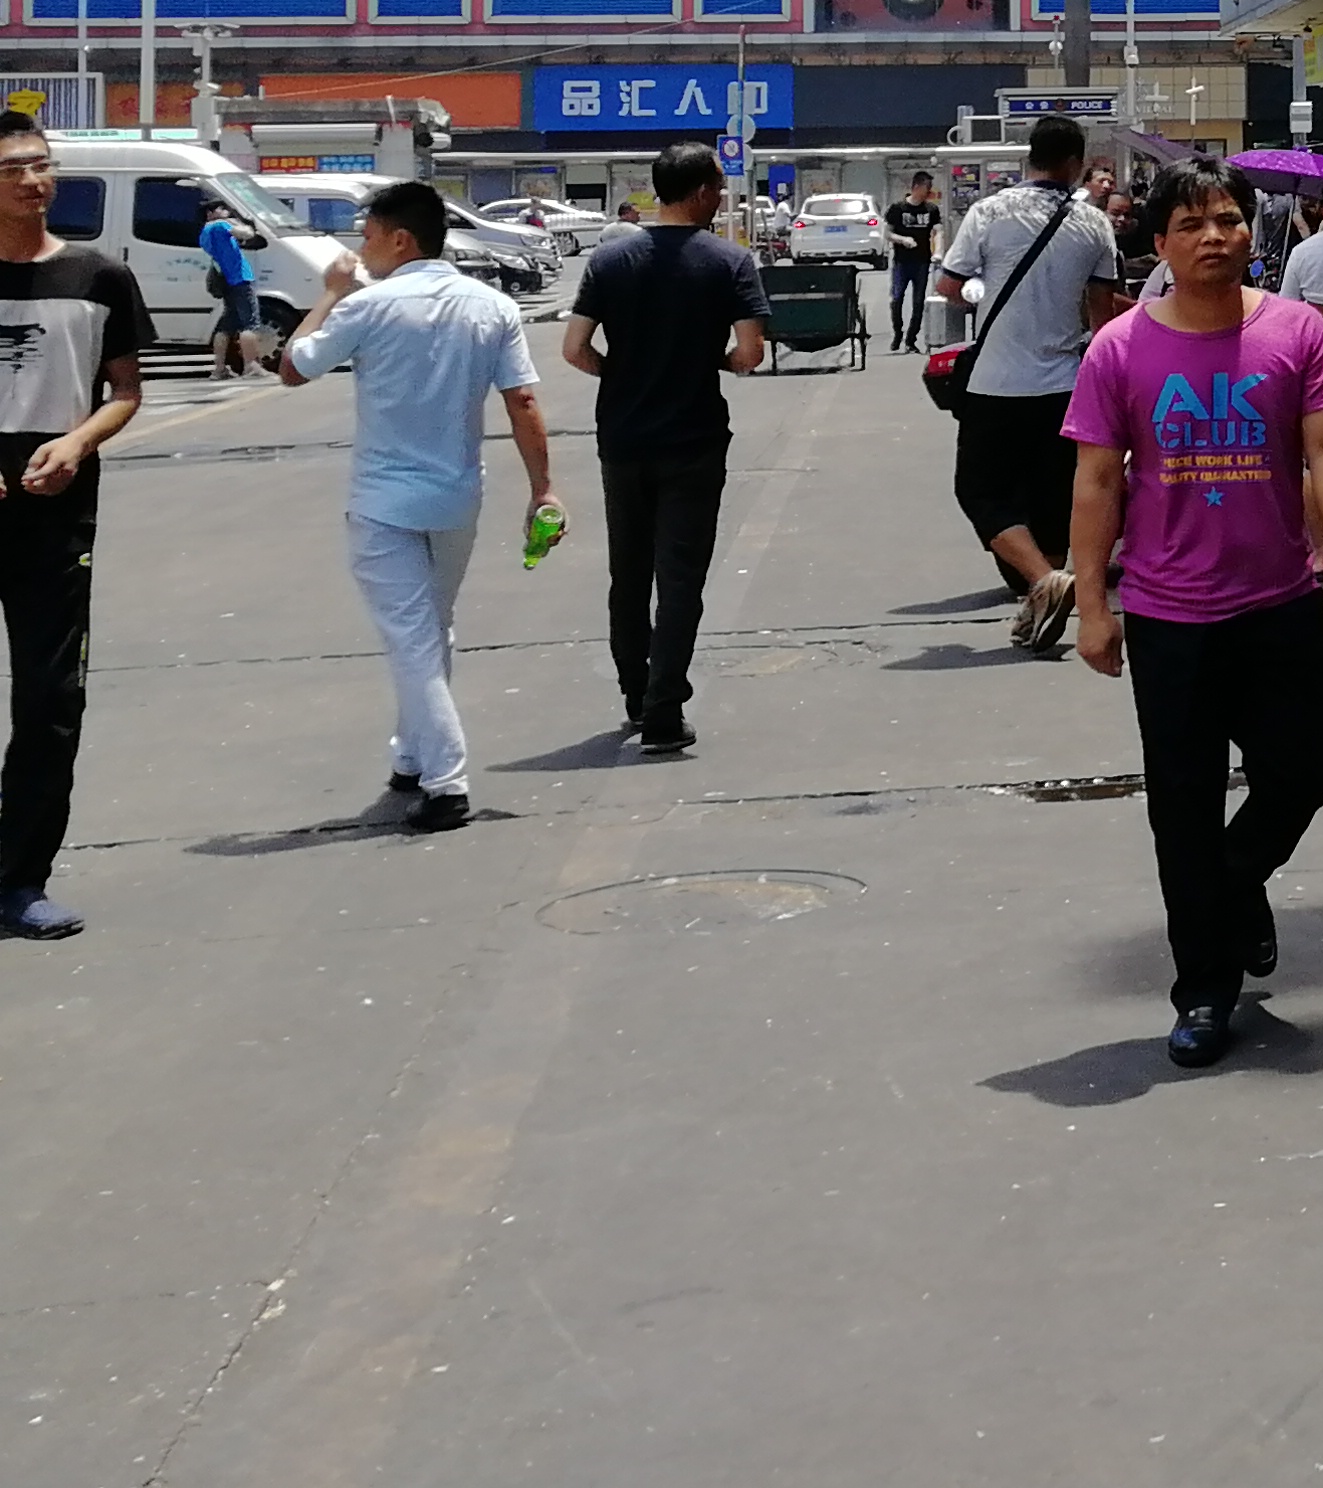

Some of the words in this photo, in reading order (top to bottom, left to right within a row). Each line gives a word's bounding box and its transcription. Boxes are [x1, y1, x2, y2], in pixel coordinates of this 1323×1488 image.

[1070, 100, 1103, 110] POLICE
[1151, 372, 1270, 424] AK
[1154, 420, 1267, 449] CLUB
